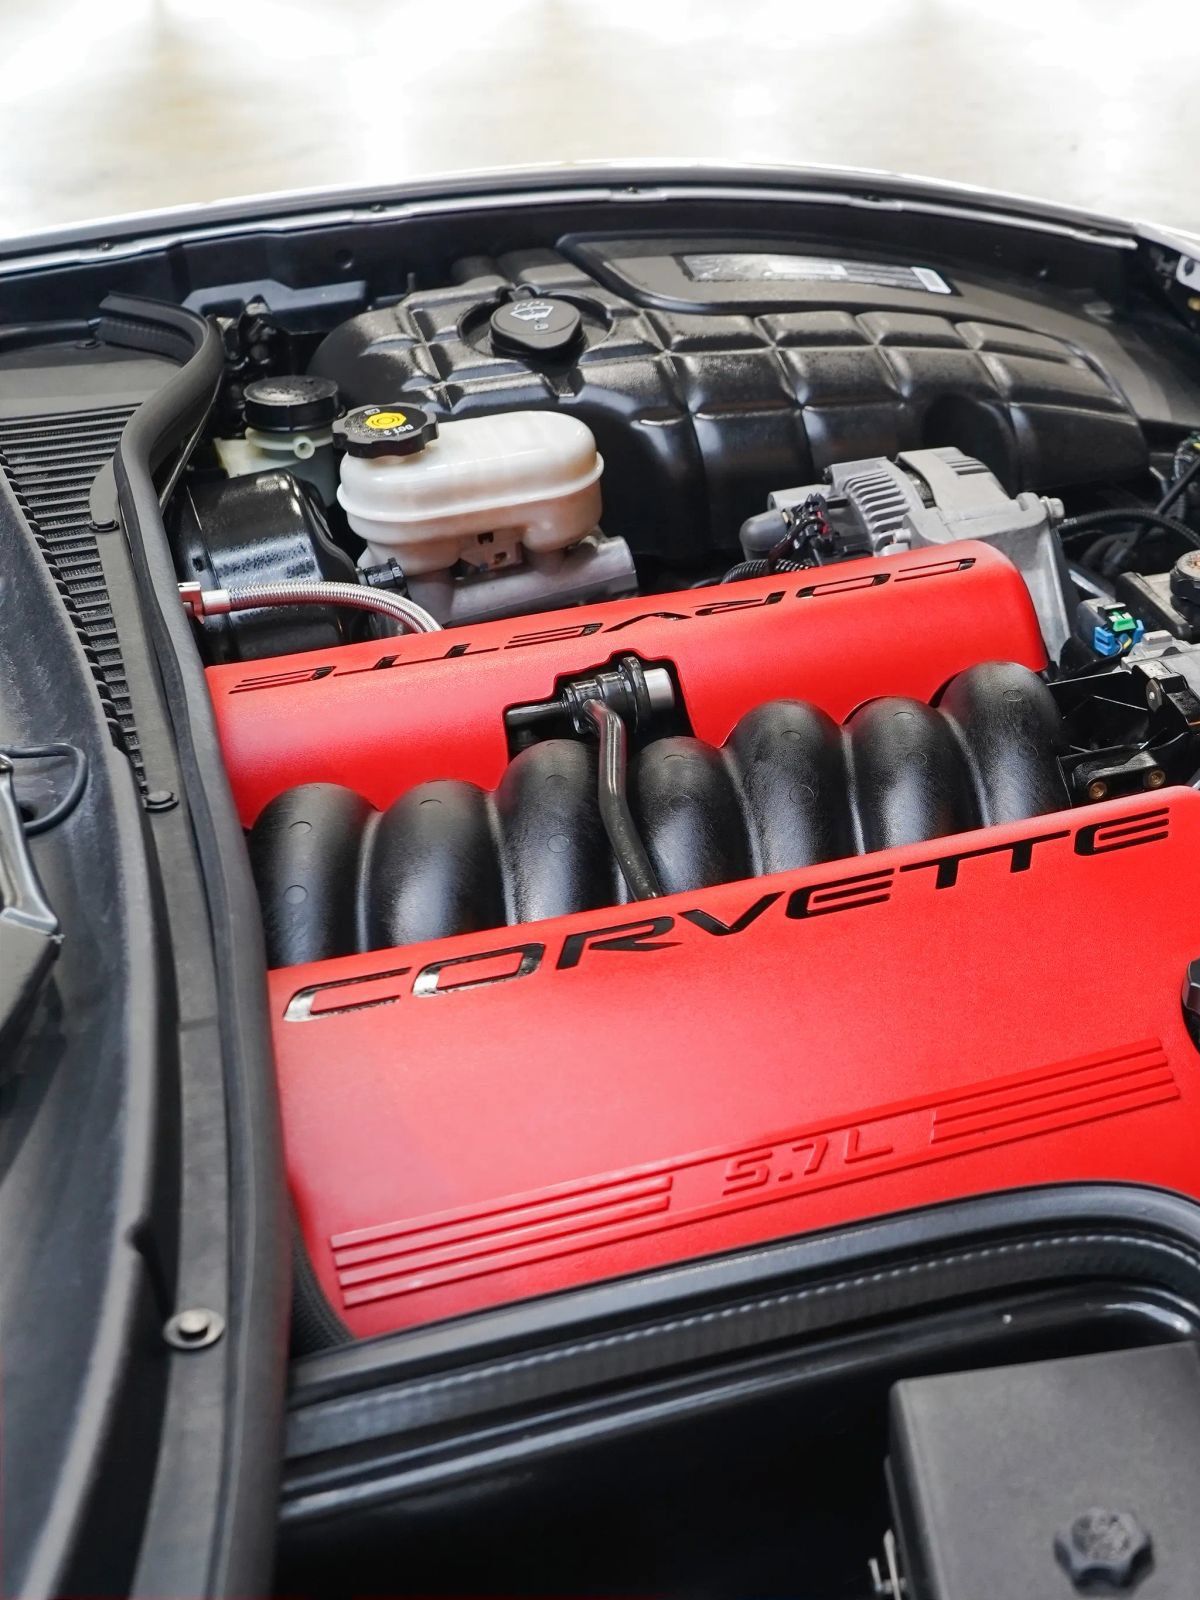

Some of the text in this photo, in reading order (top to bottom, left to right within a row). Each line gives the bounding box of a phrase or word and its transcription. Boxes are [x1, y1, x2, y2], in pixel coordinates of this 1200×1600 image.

[230, 557, 977, 695] CORVETTE
[283, 807, 1170, 1023] CORVETTE
[722, 1127, 892, 1196] 5.7L
